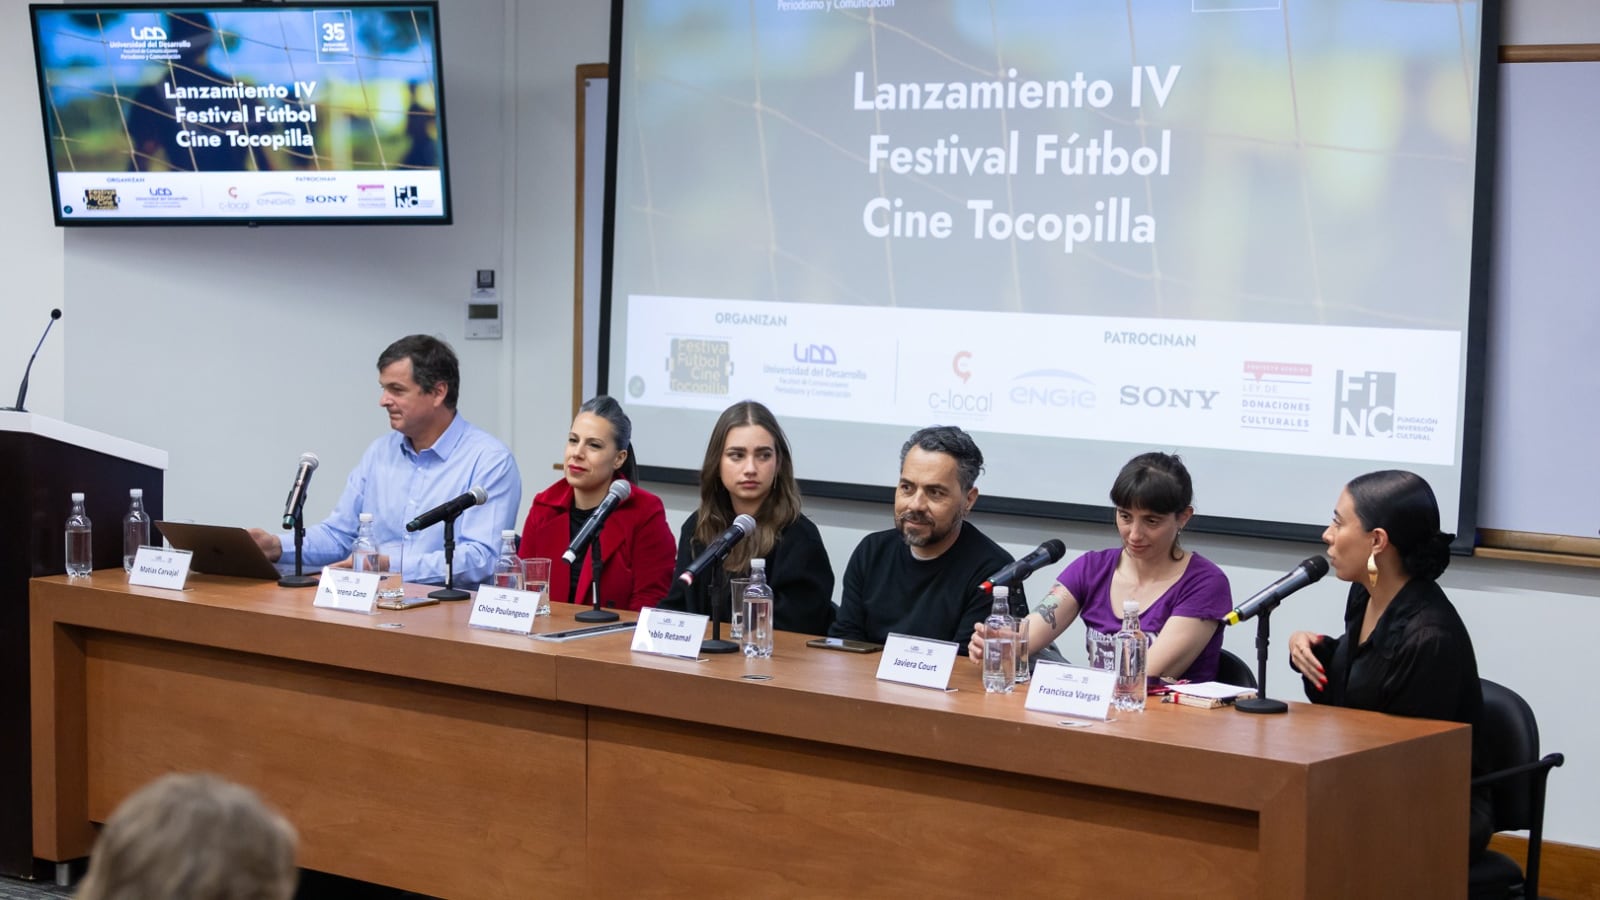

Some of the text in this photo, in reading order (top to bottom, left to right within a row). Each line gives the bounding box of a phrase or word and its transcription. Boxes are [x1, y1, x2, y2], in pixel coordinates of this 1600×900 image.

[322, 23, 346, 41] 35
[164, 81, 317, 99] Lanzamiento IV
[854, 65, 1182, 111] Lanzamiento IV
[175, 104, 317, 123] Festival Fútbol
[176, 128, 314, 151] Cine Tocopilla
[869, 129, 1171, 176] Festival Fútbol
[305, 195, 348, 203] SONY
[863, 196, 1156, 254] Cine Tocopilla
[715, 312, 788, 327] ORGANIZAN
[1104, 331, 1196, 347] PATROCINAN
[794, 342, 838, 364] UDD
[763, 364, 867, 380] Universidad del Desarrollo
[1242, 383, 1279, 393] LEY DE
[928, 388, 993, 412] c-local
[1119, 385, 1220, 410] SONY
[1242, 400, 1311, 412] DONACIONES
[1241, 416, 1310, 428] CULTURALES
[158, 567, 180, 577] Carvajal
[352, 589, 367, 598] Cano
[478, 604, 495, 614] Chloe
[648, 629, 692, 642] ablo Retamal
[893, 657, 937, 672] Javiera Court
[1038, 685, 1101, 702] Francisca Vargas
